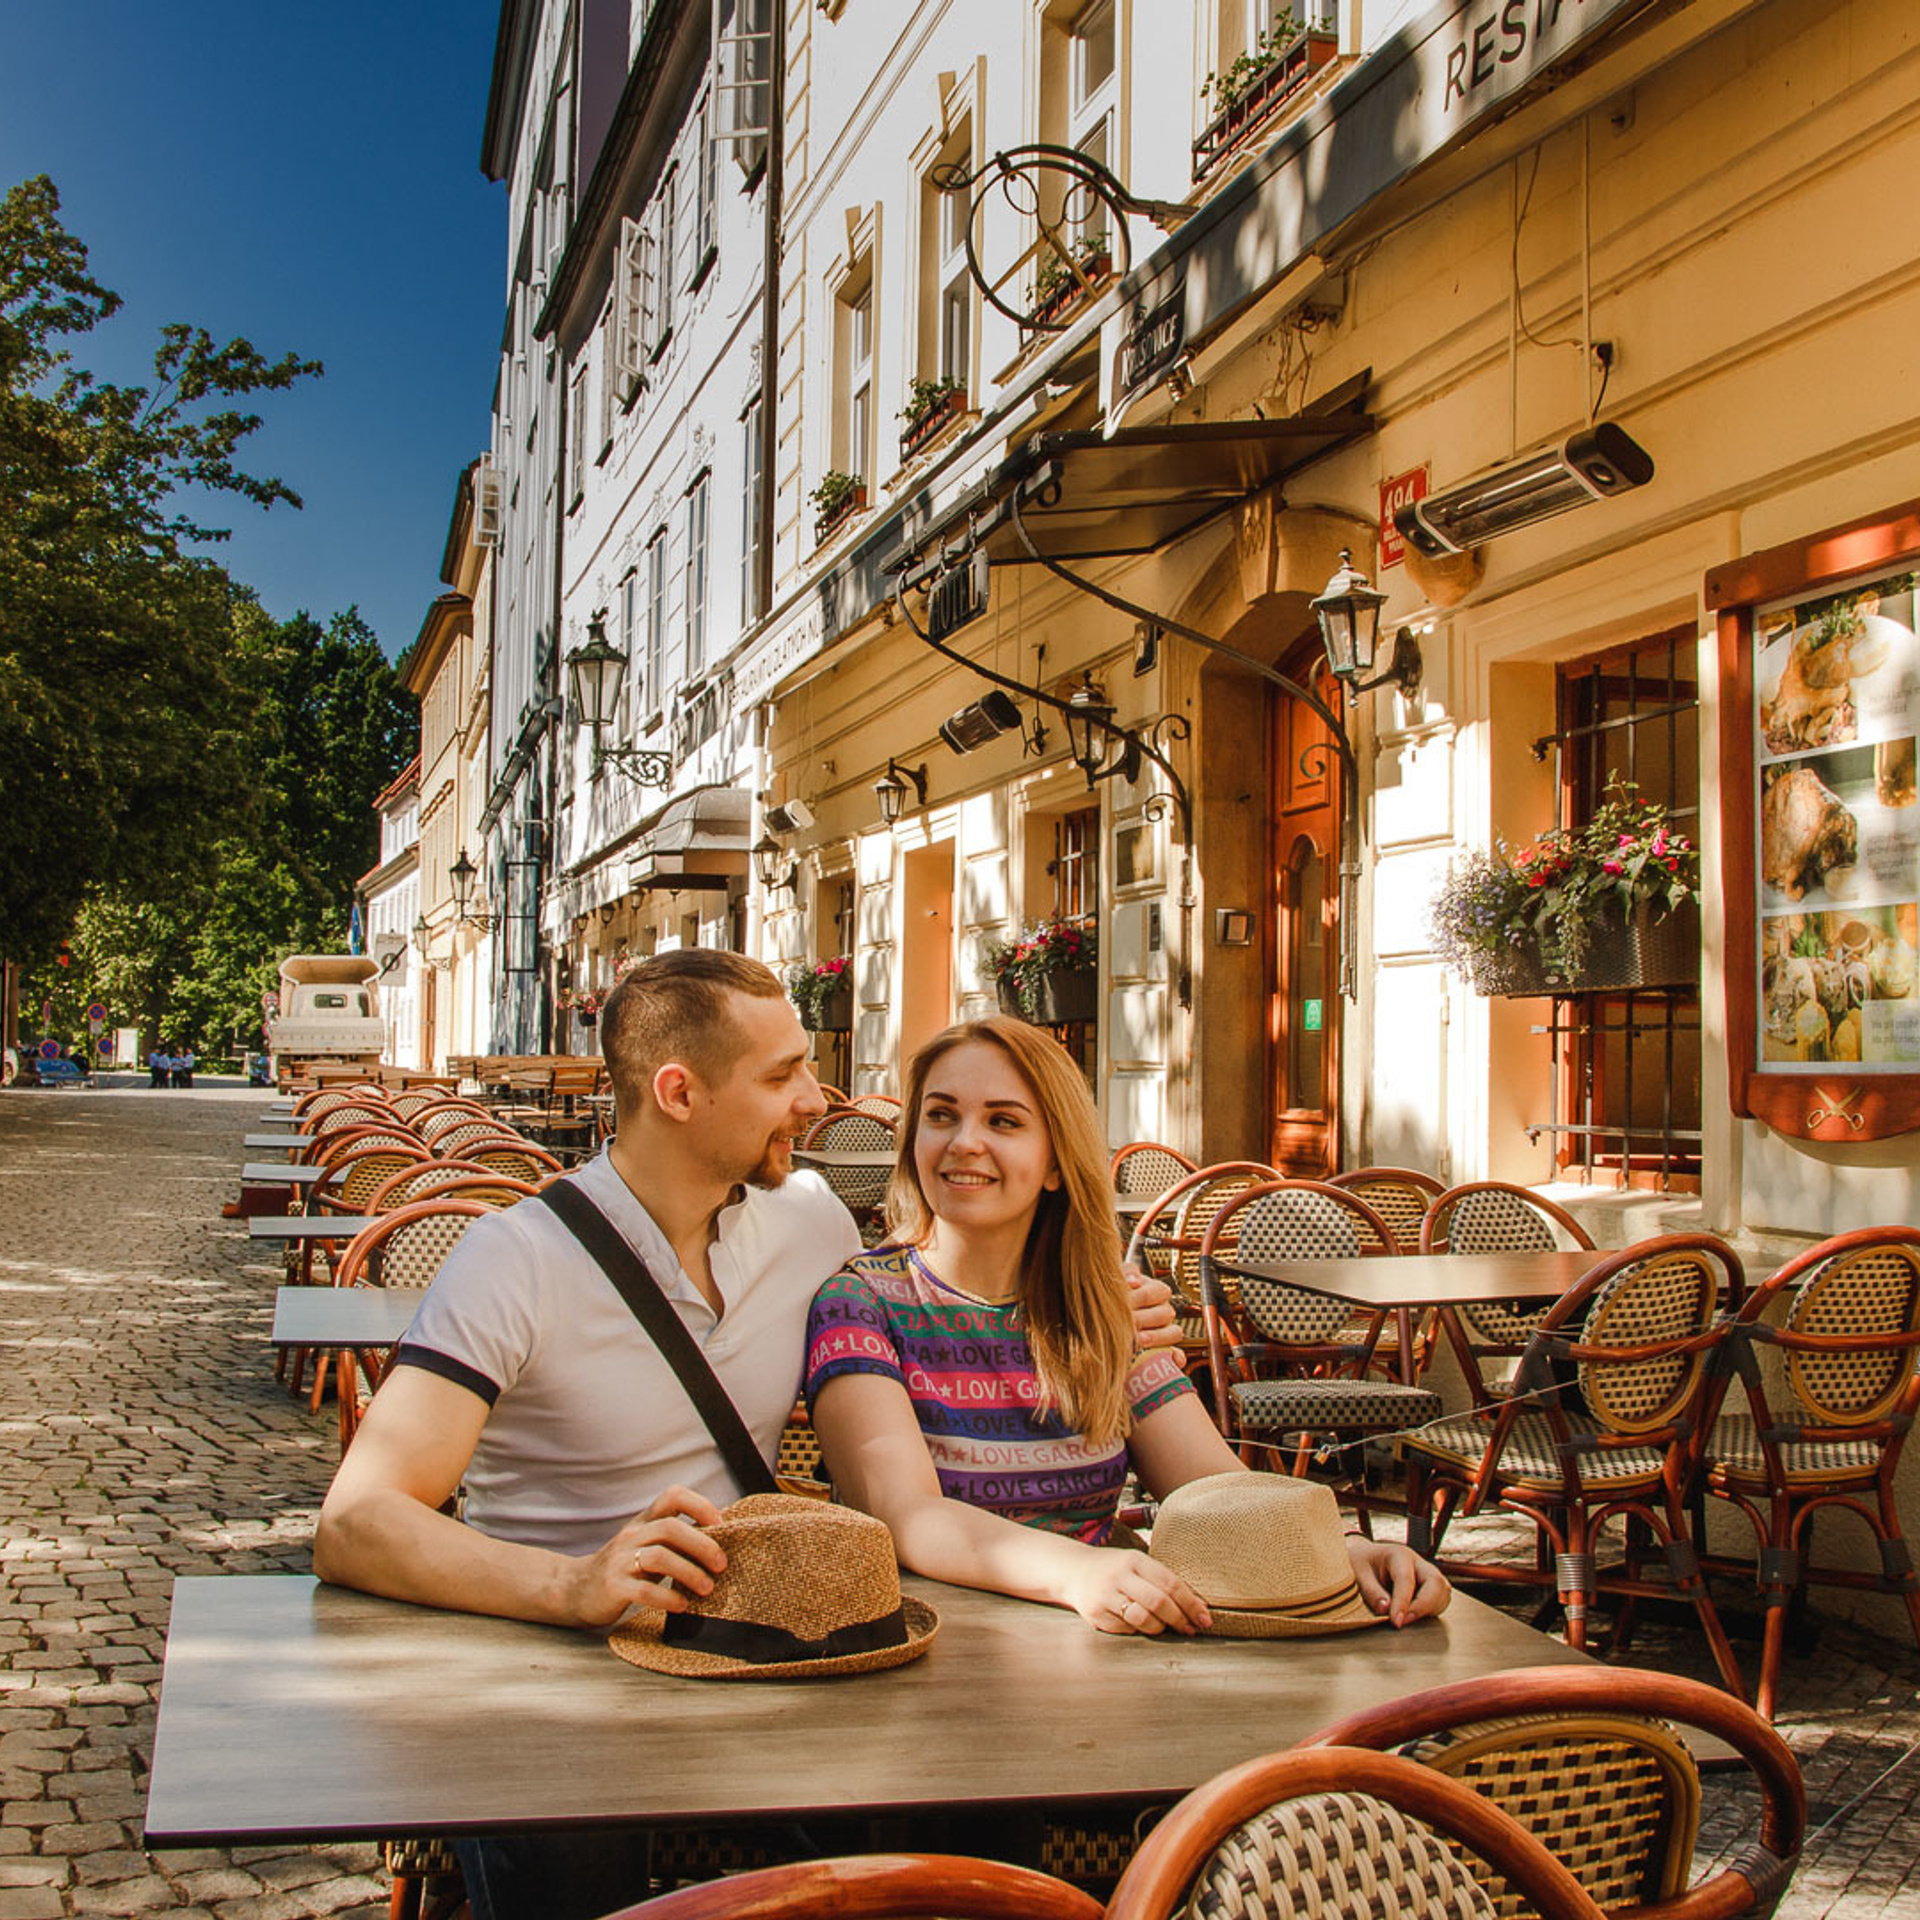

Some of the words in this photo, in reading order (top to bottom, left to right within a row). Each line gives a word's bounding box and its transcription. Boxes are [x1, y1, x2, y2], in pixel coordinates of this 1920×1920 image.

[941, 1311, 999, 1332] LOVE
[953, 1345, 1007, 1366] LOVE
[956, 1379, 1014, 1400] LOVE
[970, 1446, 1029, 1465] LOVE
[1033, 1437, 1116, 1464] GARCIA
[969, 1479, 1033, 1500] LOVE
[1037, 1463, 1122, 1495] GARCIA
